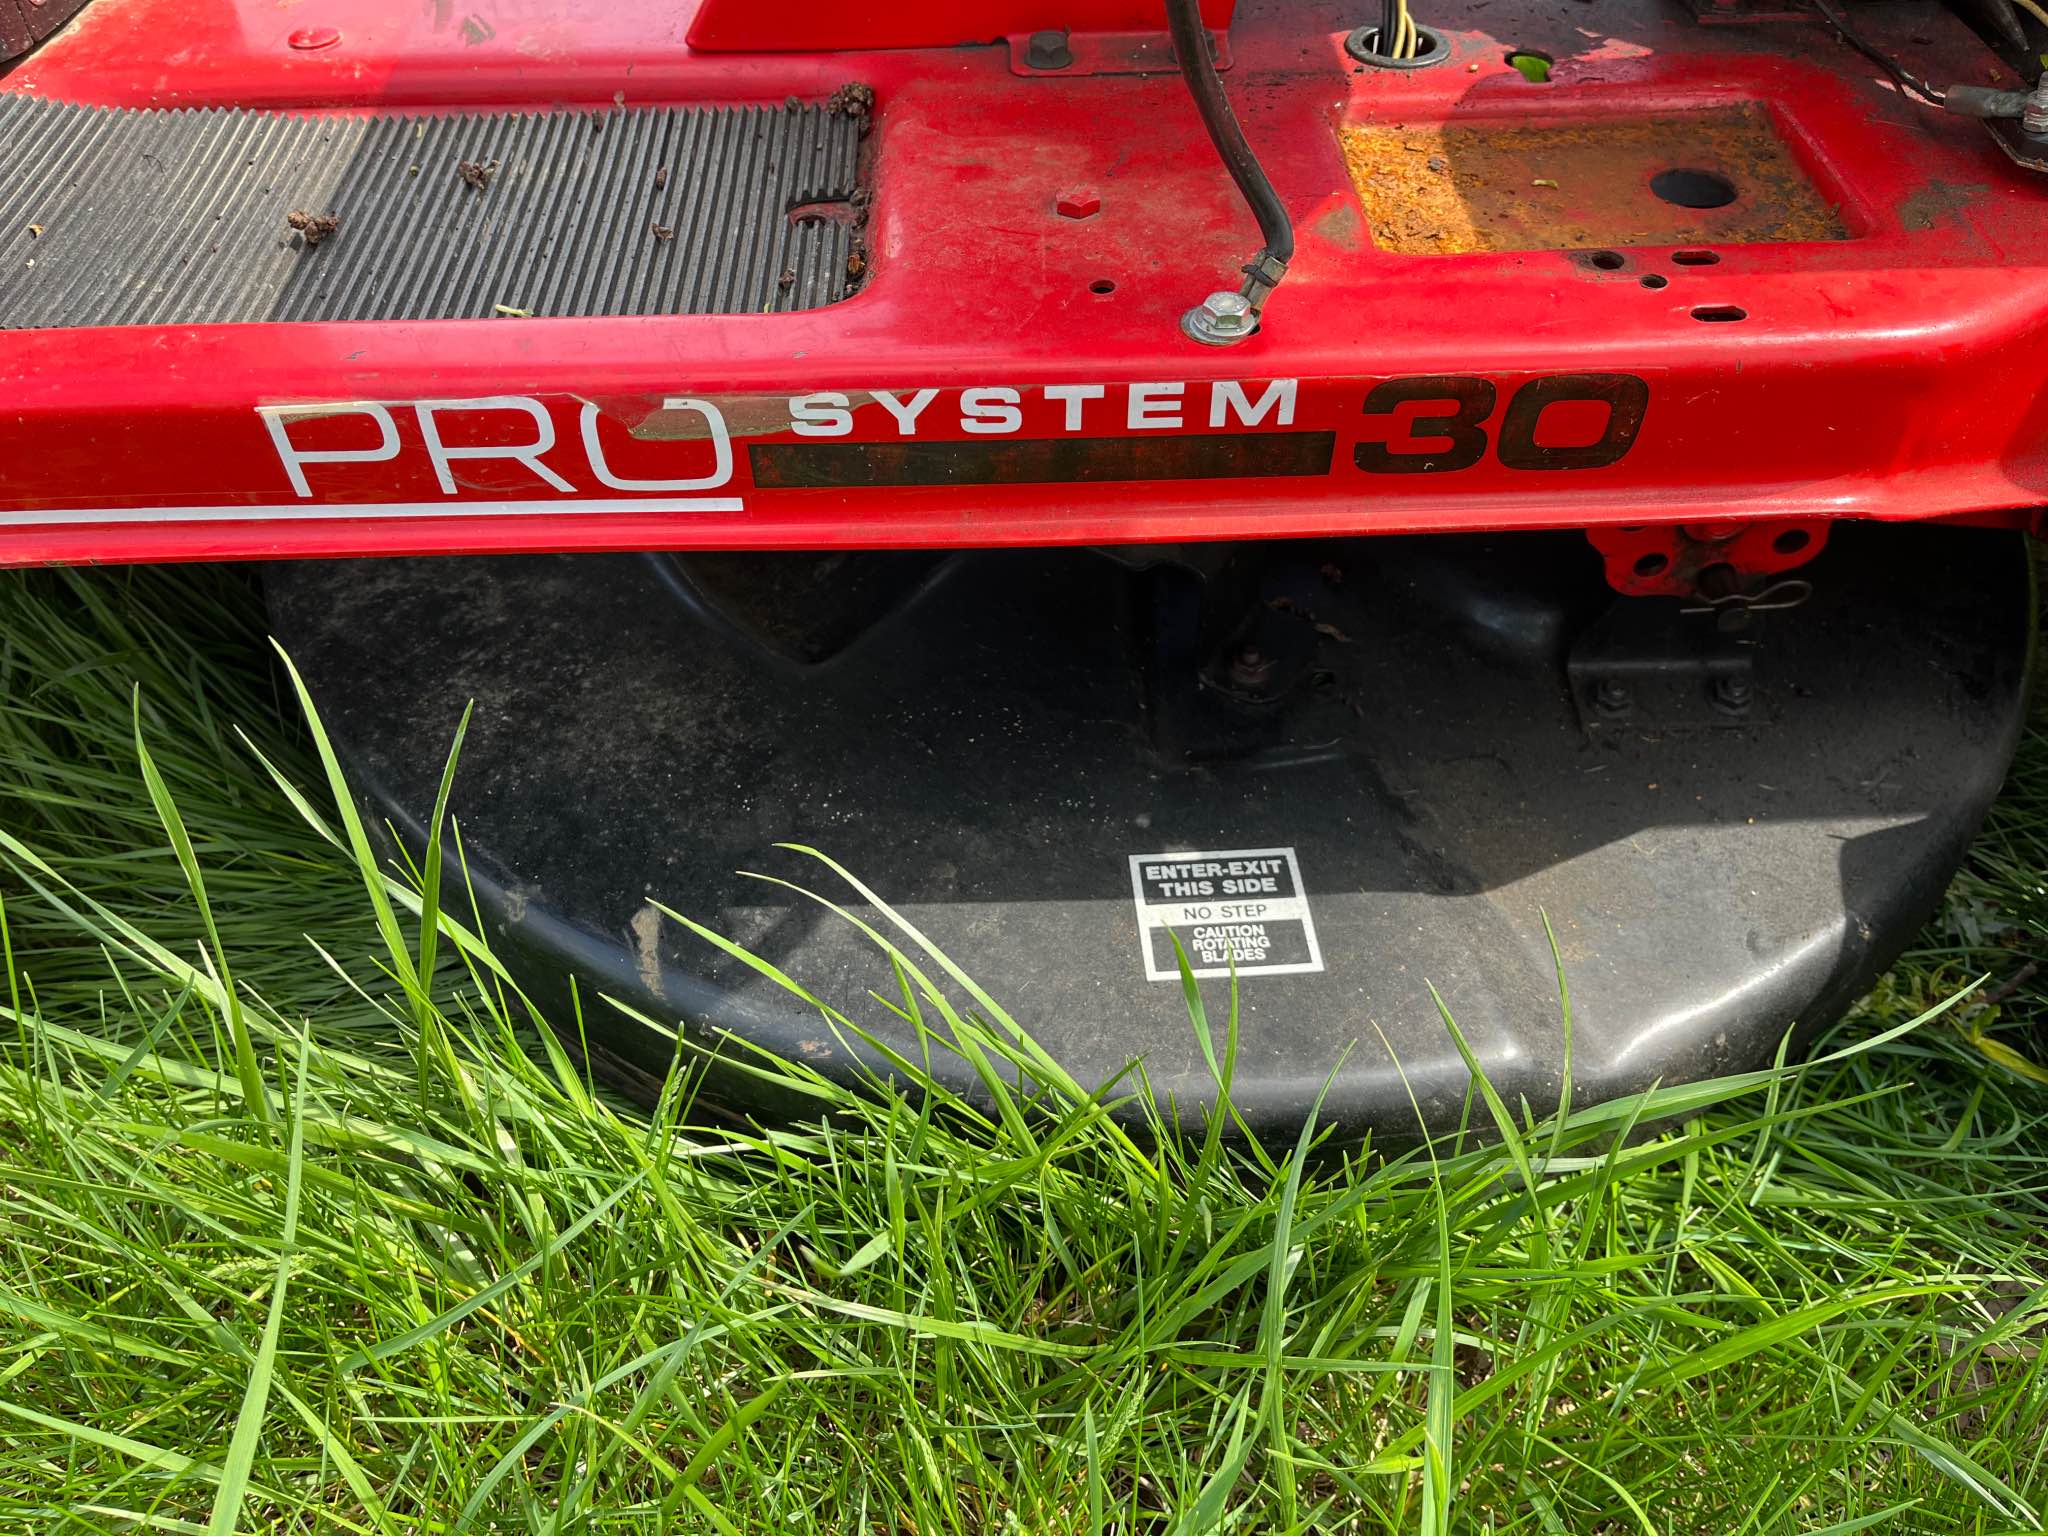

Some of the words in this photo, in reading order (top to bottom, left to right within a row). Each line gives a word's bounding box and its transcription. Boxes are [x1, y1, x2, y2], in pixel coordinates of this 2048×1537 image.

[254, 396, 733, 498] PRO
[789, 378, 1298, 437] SYSTEM
[1354, 373, 1649, 474] 30
[1145, 860, 1282, 880] ENTER-EXIT
[1159, 881, 1214, 896] THIS
[1222, 878, 1277, 894] SIDE
[1184, 906, 1212, 920] NO
[1220, 904, 1267, 918] STEP
[1193, 924, 1265, 939] CAUTION
